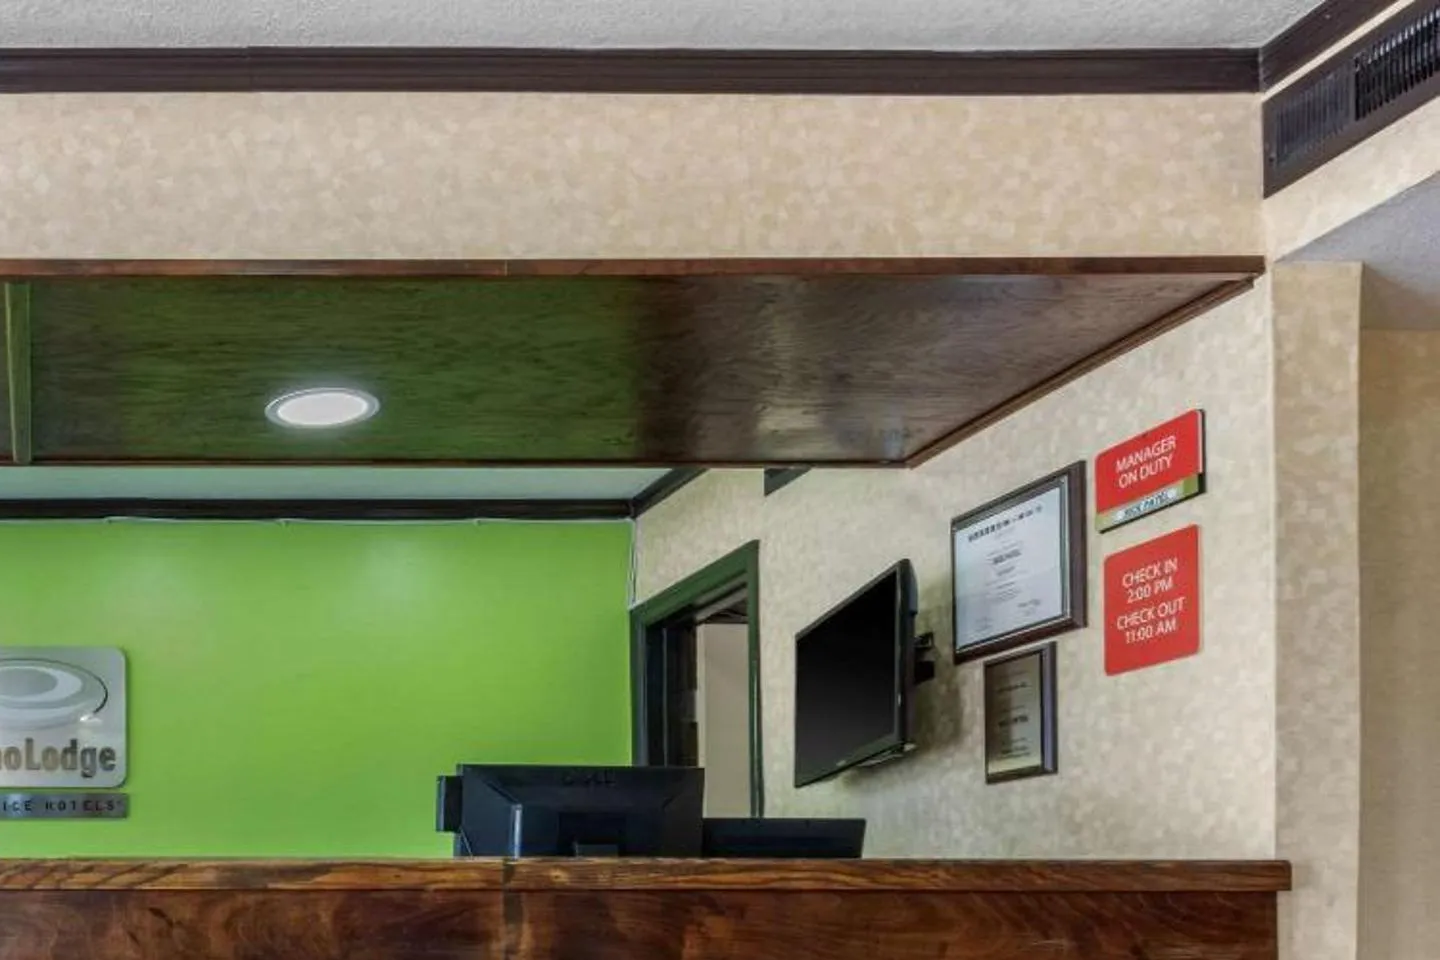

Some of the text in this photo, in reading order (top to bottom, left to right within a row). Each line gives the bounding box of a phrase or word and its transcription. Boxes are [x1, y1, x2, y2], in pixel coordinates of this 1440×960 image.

[1115, 435, 1176, 473] MANAGER
[1118, 453, 1173, 489] ON DUTY
[1122, 557, 1178, 588] CHECK IN
[1127, 575, 1173, 604] 2:00 PM
[1117, 596, 1186, 630] CHECK OUT
[1125, 616, 1177, 645] 11:00 AM
[45, 799, 116, 812] HOTELS
